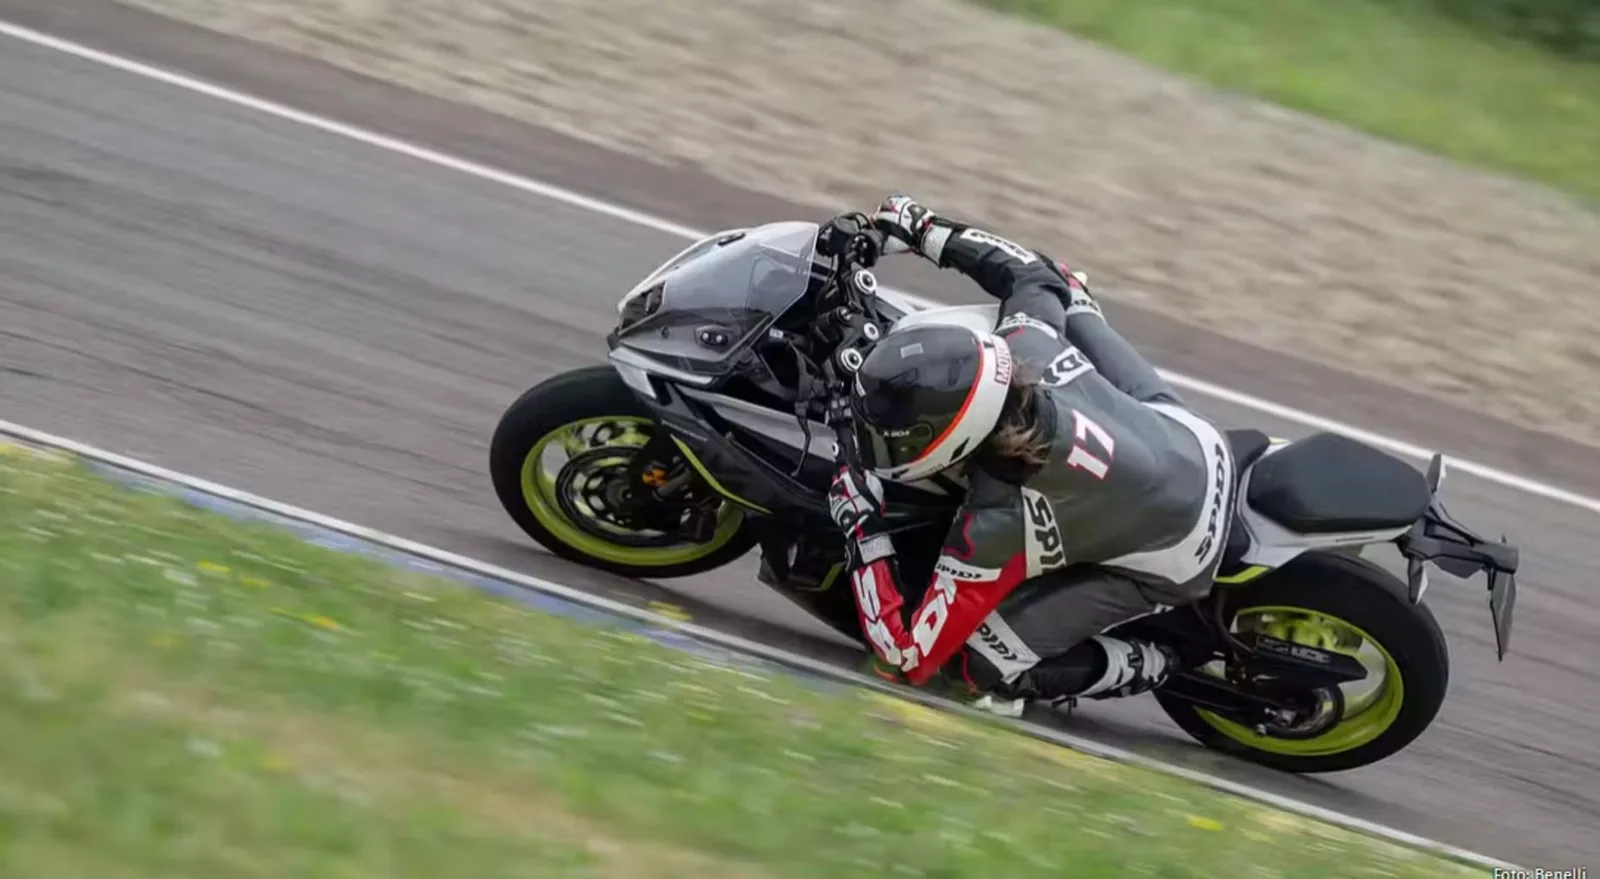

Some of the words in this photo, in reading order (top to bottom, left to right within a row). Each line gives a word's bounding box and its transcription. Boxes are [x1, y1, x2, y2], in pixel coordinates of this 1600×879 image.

[1067, 408, 1114, 479] 17
[1024, 495, 1063, 570] SPI
[976, 622, 1017, 660] PIDI
